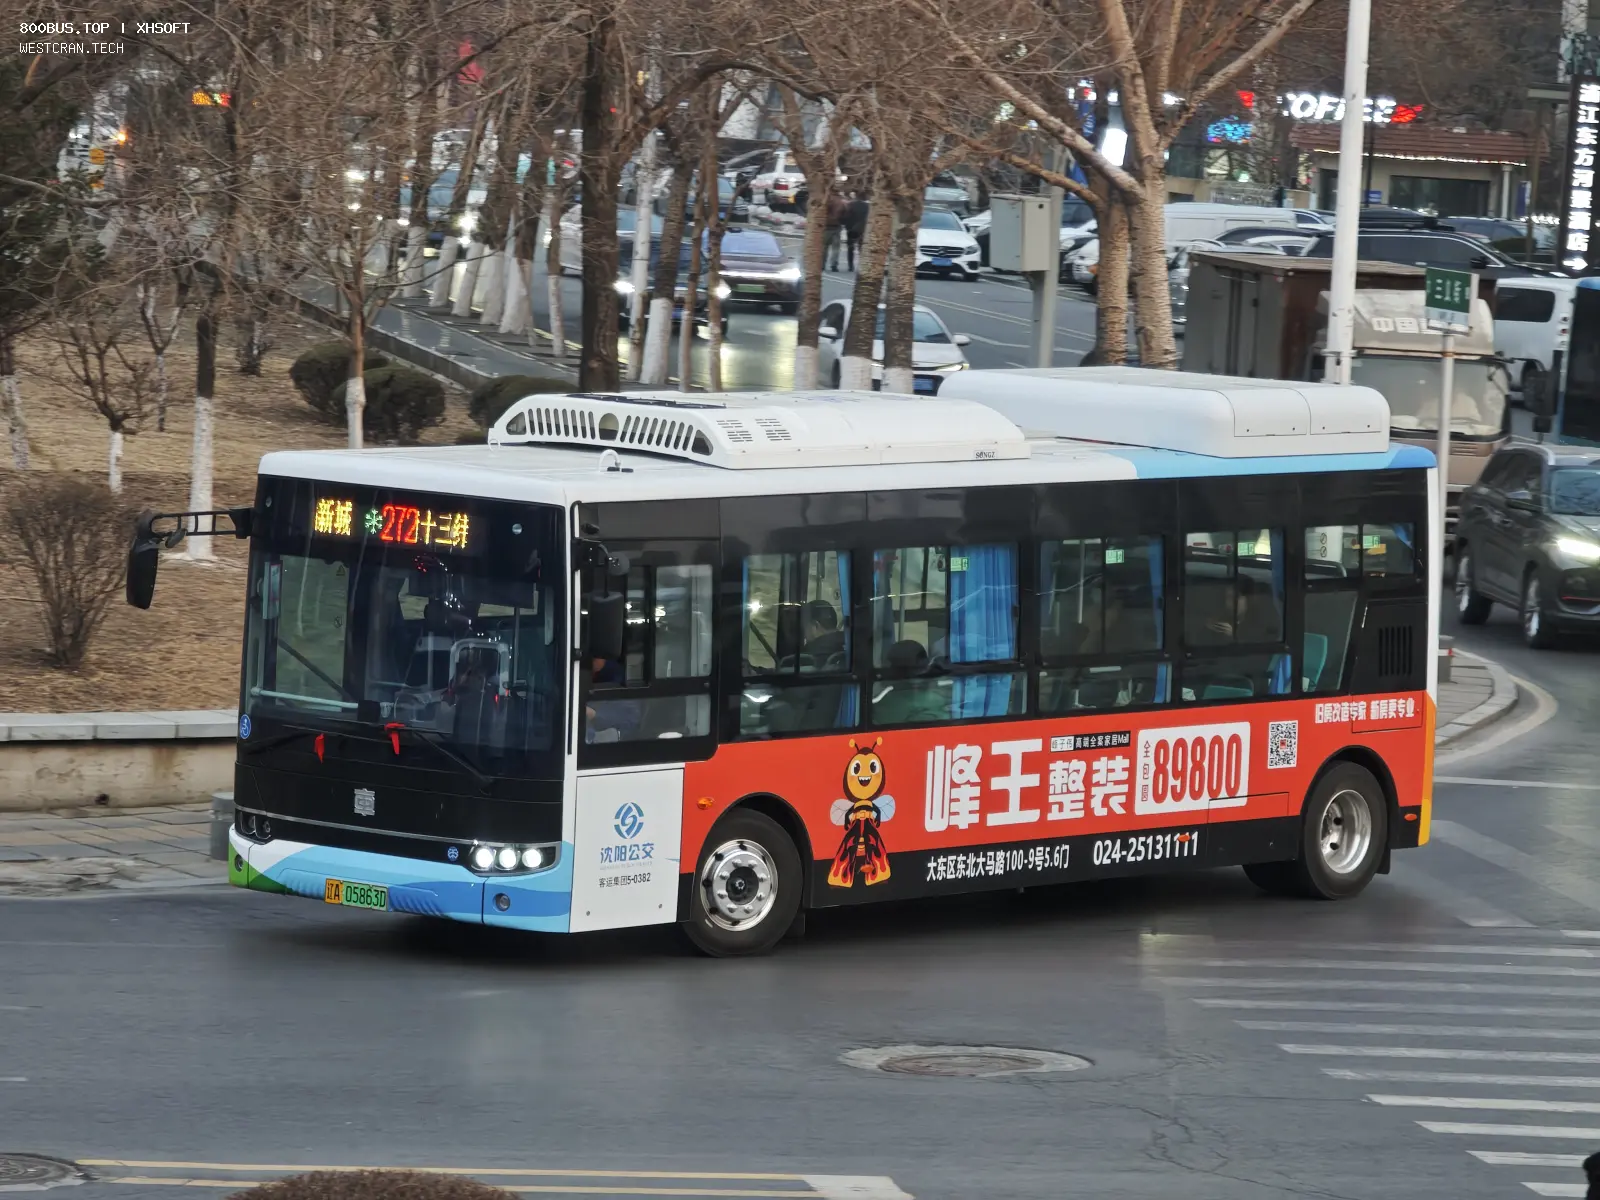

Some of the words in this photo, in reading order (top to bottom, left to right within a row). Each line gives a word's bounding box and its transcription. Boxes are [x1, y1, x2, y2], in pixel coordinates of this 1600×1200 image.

[315, 498, 353, 536] 新城
[380, 504, 418, 544] 272
[1315, 701, 1367, 724] 旧房改造专家
[1152, 733, 1243, 804] 89800
[600, 842, 655, 864] 沈阳公交
[1093, 831, 1199, 866] 024-25131111
[599, 872, 652, 888] 客运集团5-0382
